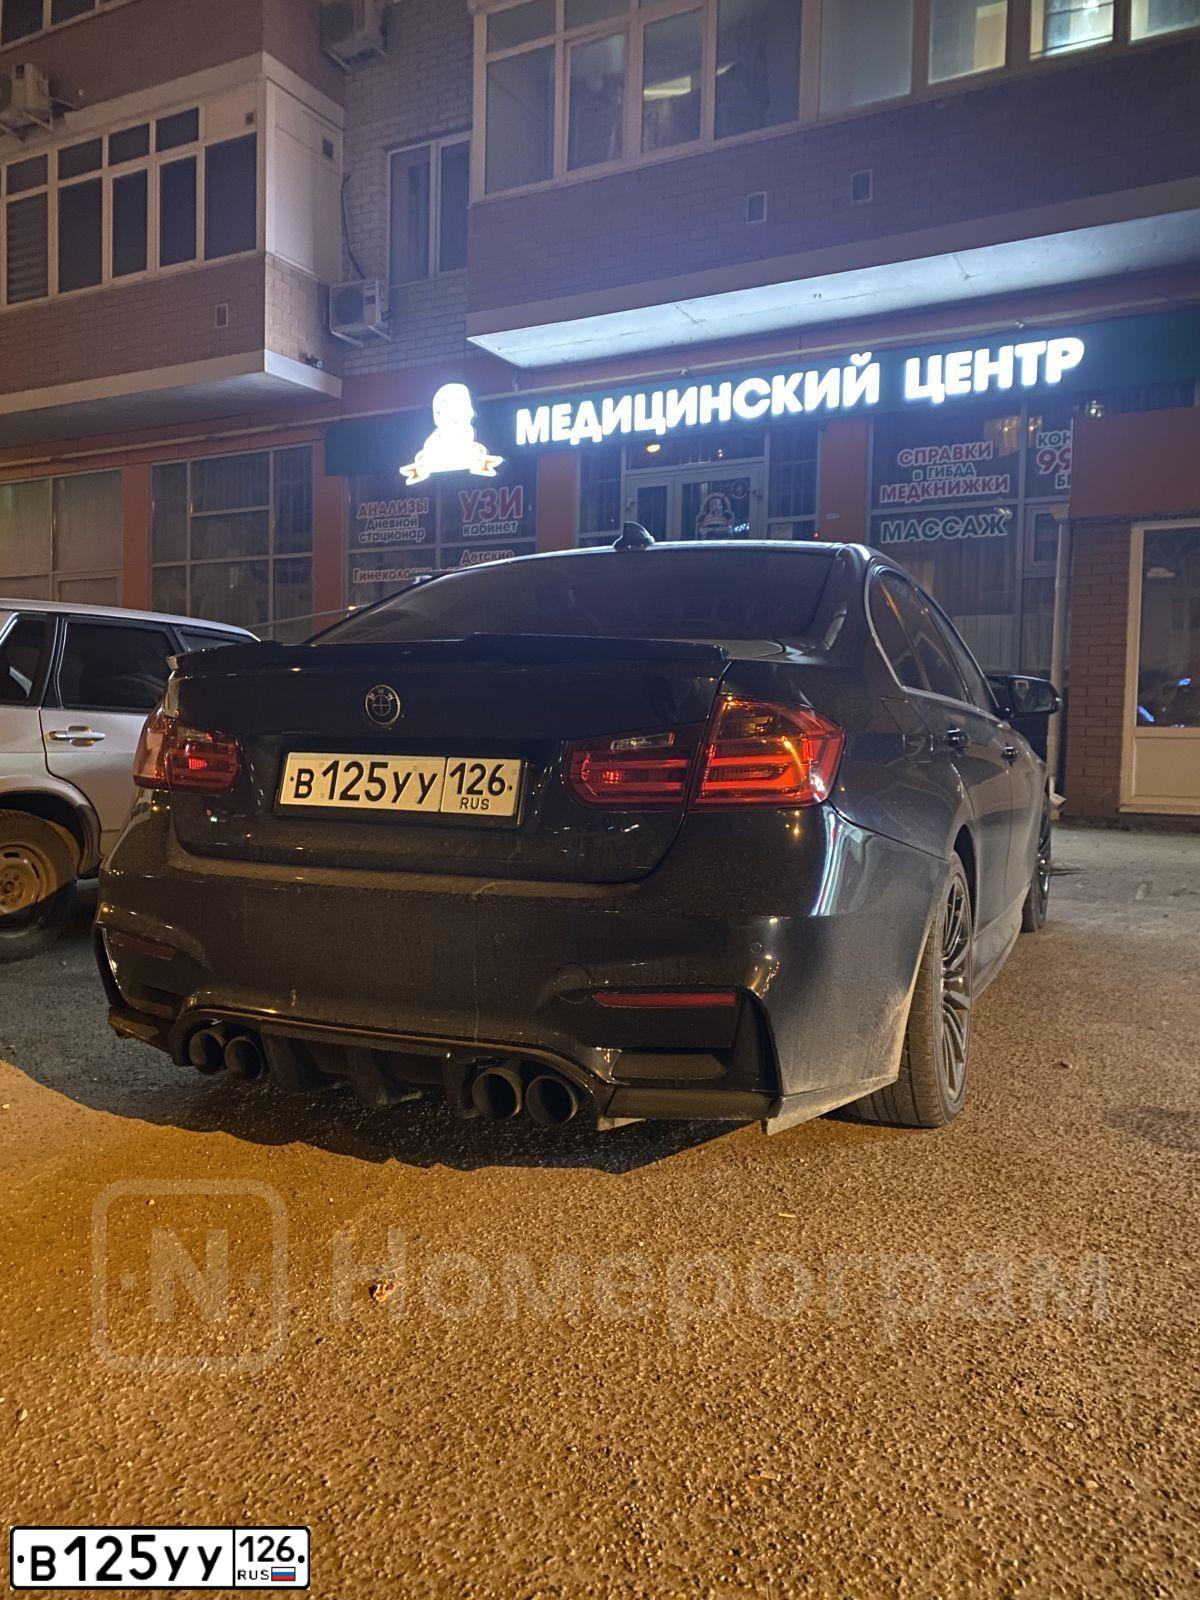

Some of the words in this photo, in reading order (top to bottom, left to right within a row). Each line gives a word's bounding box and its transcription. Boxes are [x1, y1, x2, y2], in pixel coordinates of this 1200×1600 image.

[515, 352, 881, 447] МЕДИЦИНСКИЙ
[903, 336, 1086, 407] ЦЕНТР
[898, 441, 993, 466] СПРАВКИ
[927, 463, 976, 481] ГИБДД
[880, 475, 1009, 503] МЕДКНИЖКИ
[357, 498, 429, 519] АНАЛИЗЫ
[458, 485, 524, 523] УЗИ
[365, 514, 419, 531] Дневной
[463, 520, 518, 536] кабинет
[881, 514, 1007, 543] МАССАЖ
[359, 528, 426, 543] стационар
[460, 549, 514, 566] Детские
[448, 762, 506, 797] 126
[459, 797, 490, 810] RUS
